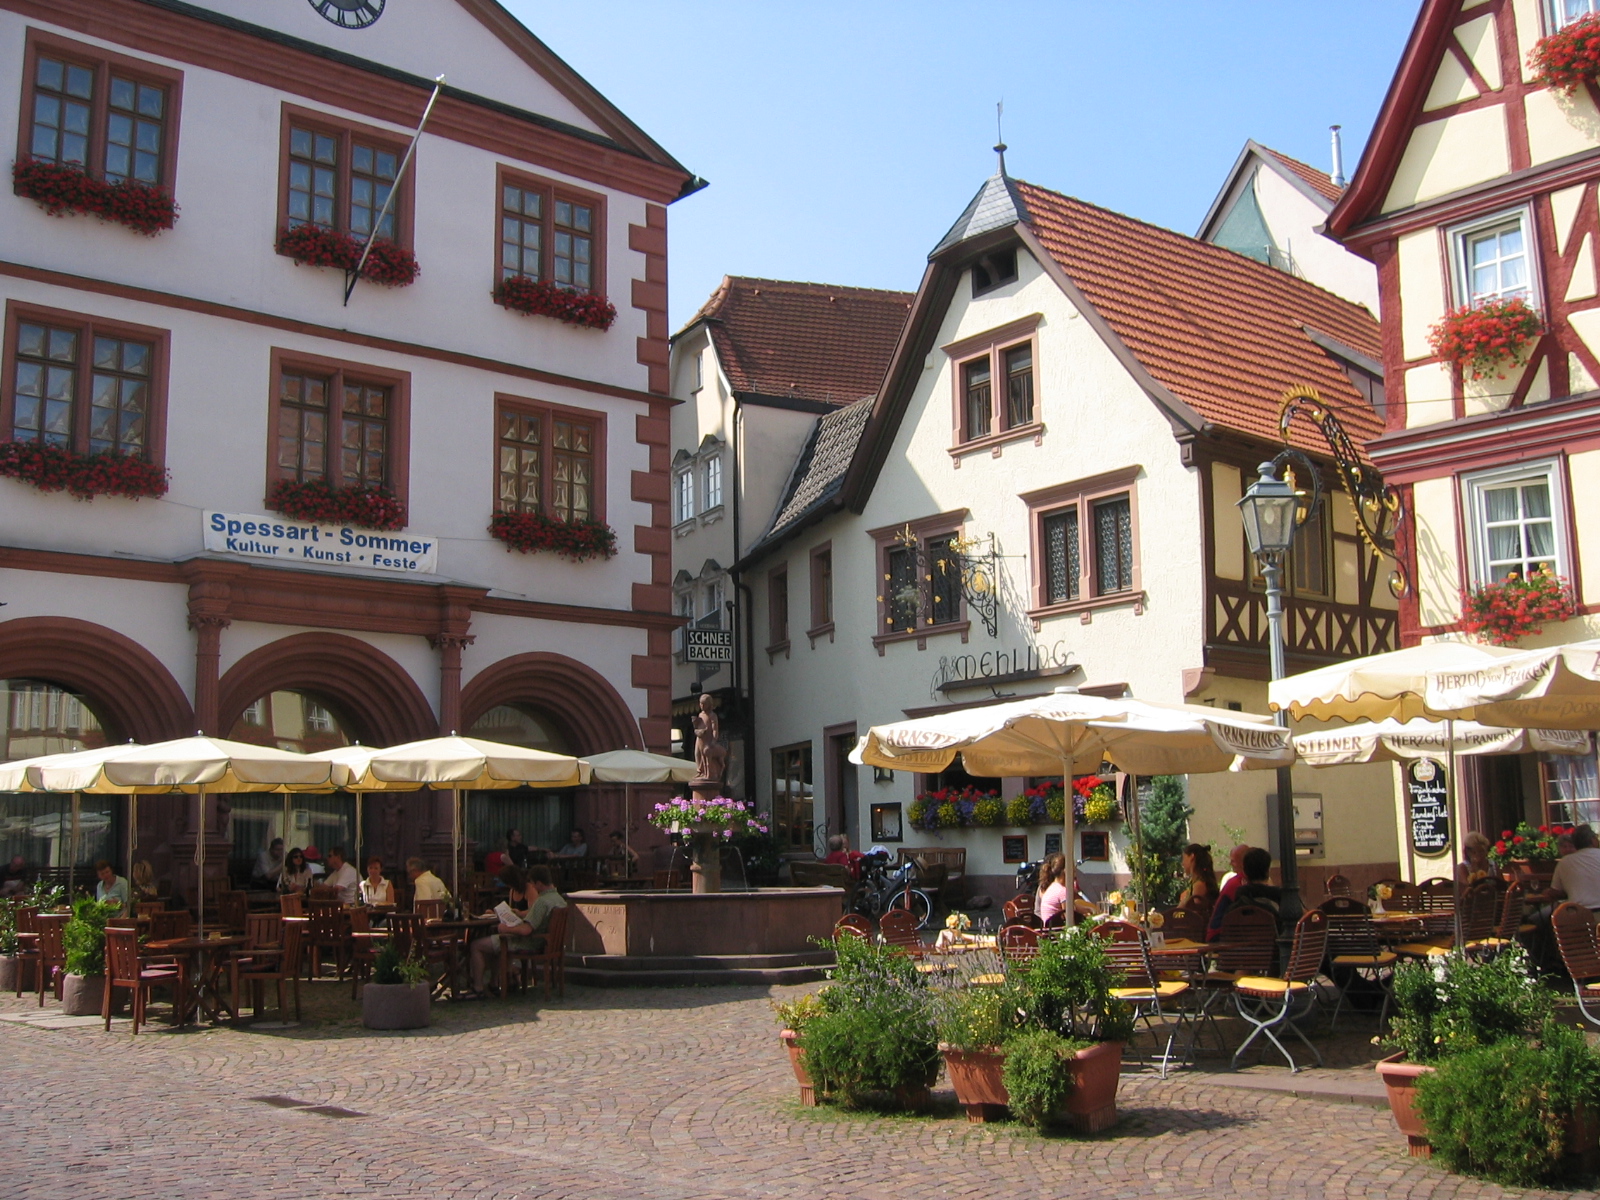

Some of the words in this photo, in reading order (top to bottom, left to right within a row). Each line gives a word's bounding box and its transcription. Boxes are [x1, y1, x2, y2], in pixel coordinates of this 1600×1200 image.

[211, 513, 319, 542] Spessart
[340, 527, 432, 555] Sommer
[226, 538, 279, 555] Kultur
[303, 546, 351, 562] Kunst
[373, 554, 417, 570] Feste
[689, 631, 731, 645] SCHNEE
[689, 646, 731, 660] BACHER
[1217, 723, 1290, 750] ARNSTEINER
[1294, 735, 1362, 754] STEINER
[1391, 733, 1445, 748] HERZOG
[1464, 728, 1516, 746] FRANKEN
